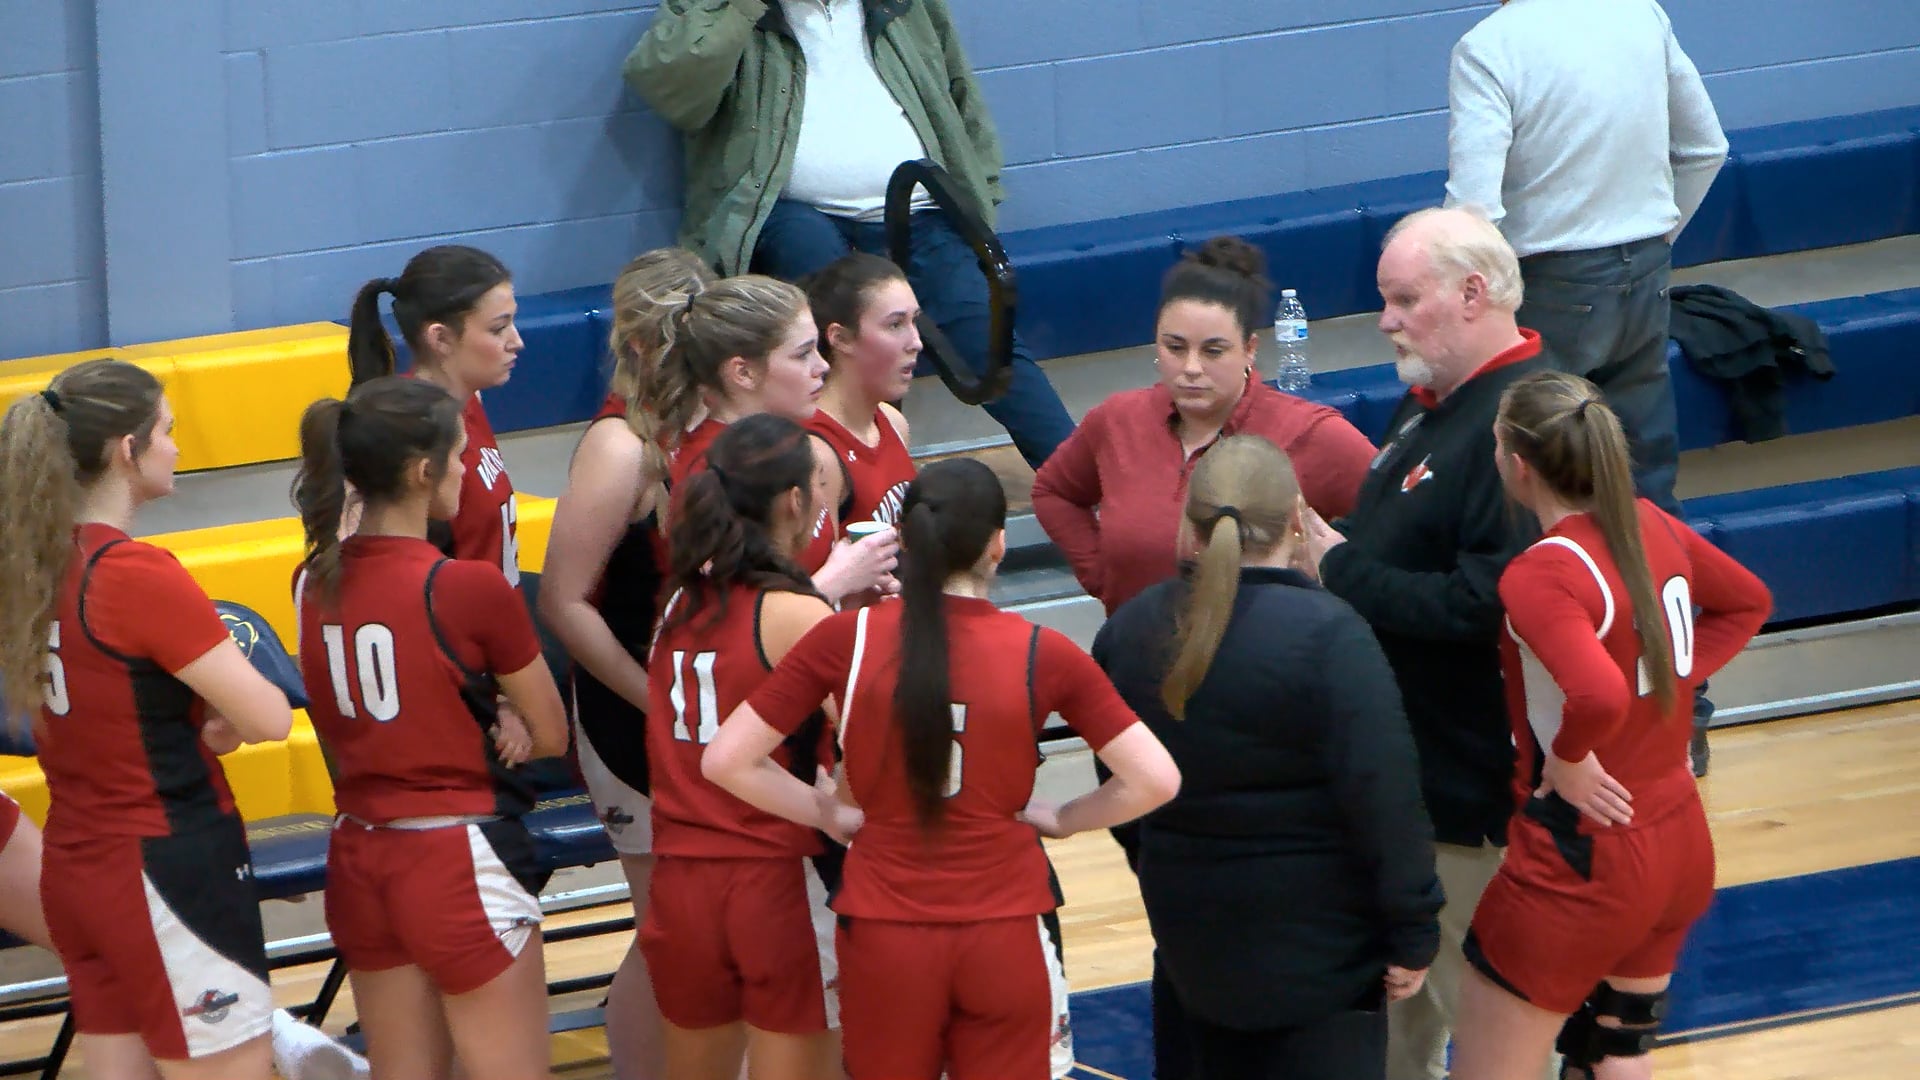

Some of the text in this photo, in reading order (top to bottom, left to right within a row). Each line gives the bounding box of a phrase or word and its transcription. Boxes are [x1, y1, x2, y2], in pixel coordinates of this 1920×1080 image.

[322, 623, 400, 720] 10
[1633, 575, 1694, 696] 0
[670, 651, 720, 744] 11
